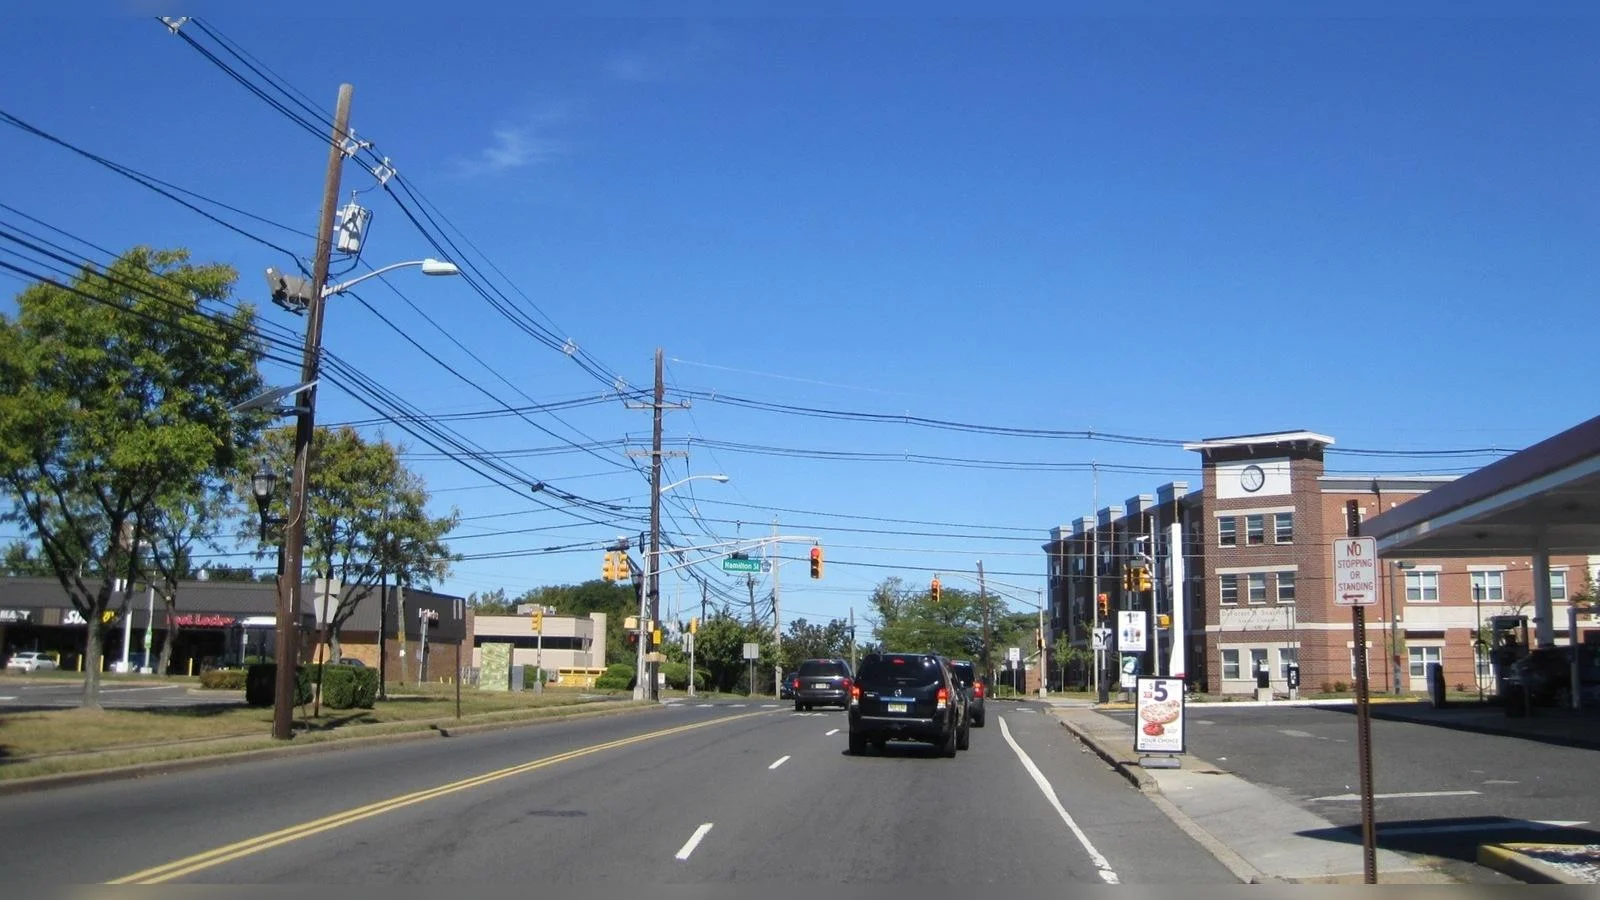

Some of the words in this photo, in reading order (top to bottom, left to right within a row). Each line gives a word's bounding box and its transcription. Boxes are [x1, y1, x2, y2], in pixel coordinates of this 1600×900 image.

[1347, 544, 1361, 556] NO
[725, 561, 752, 569] Hamilton
[753, 562, 759, 570] St
[1337, 559, 1373, 568] STOPPING
[1350, 571, 1361, 580] OR
[1338, 582, 1374, 591] STANDING
